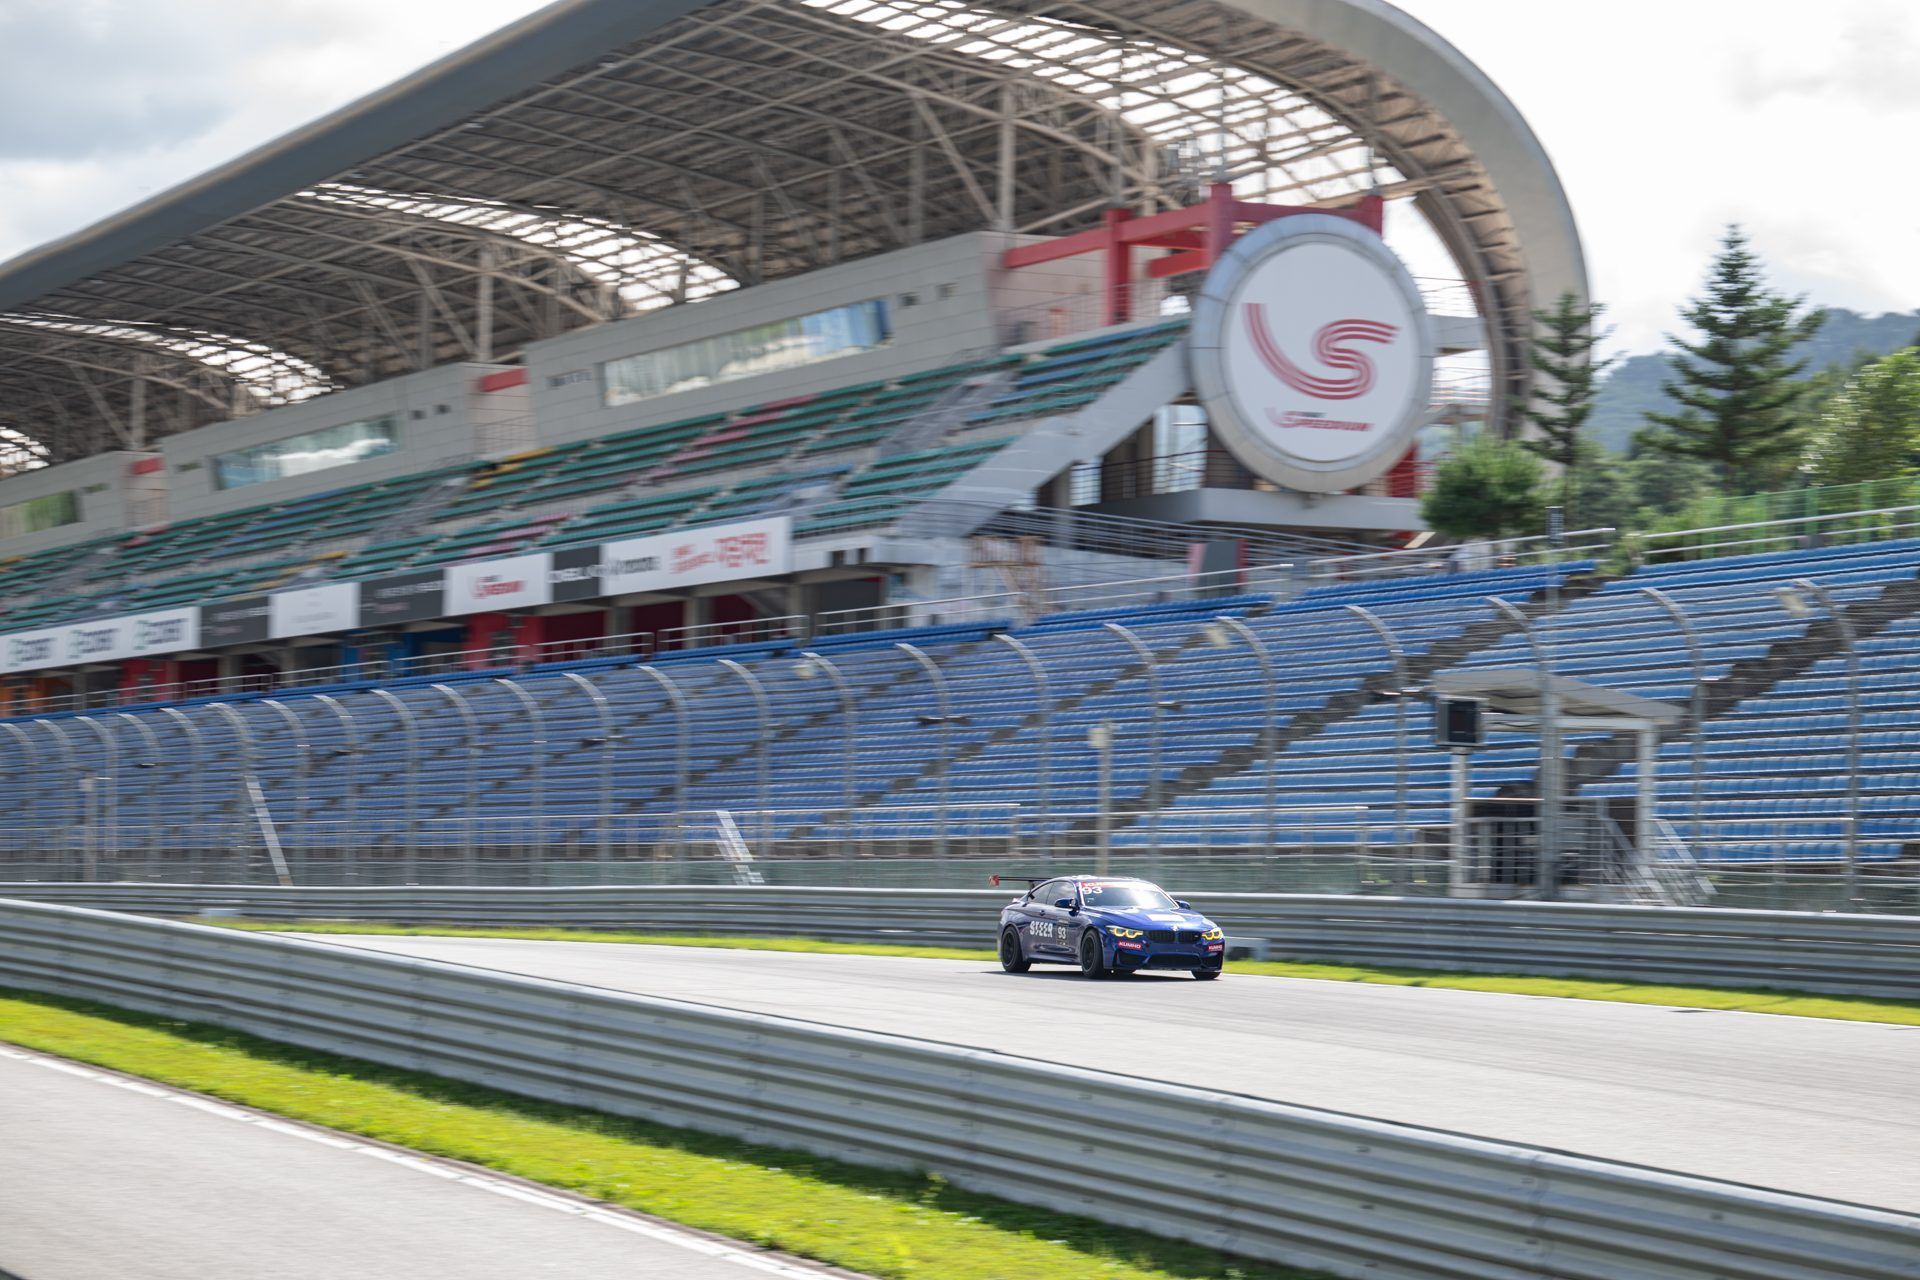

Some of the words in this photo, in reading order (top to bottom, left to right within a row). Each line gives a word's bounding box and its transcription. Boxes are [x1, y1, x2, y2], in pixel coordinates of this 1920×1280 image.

[1081, 886, 1103, 895] 93
[1030, 920, 1053, 938] STEER
[1057, 926, 1067, 940] 93
